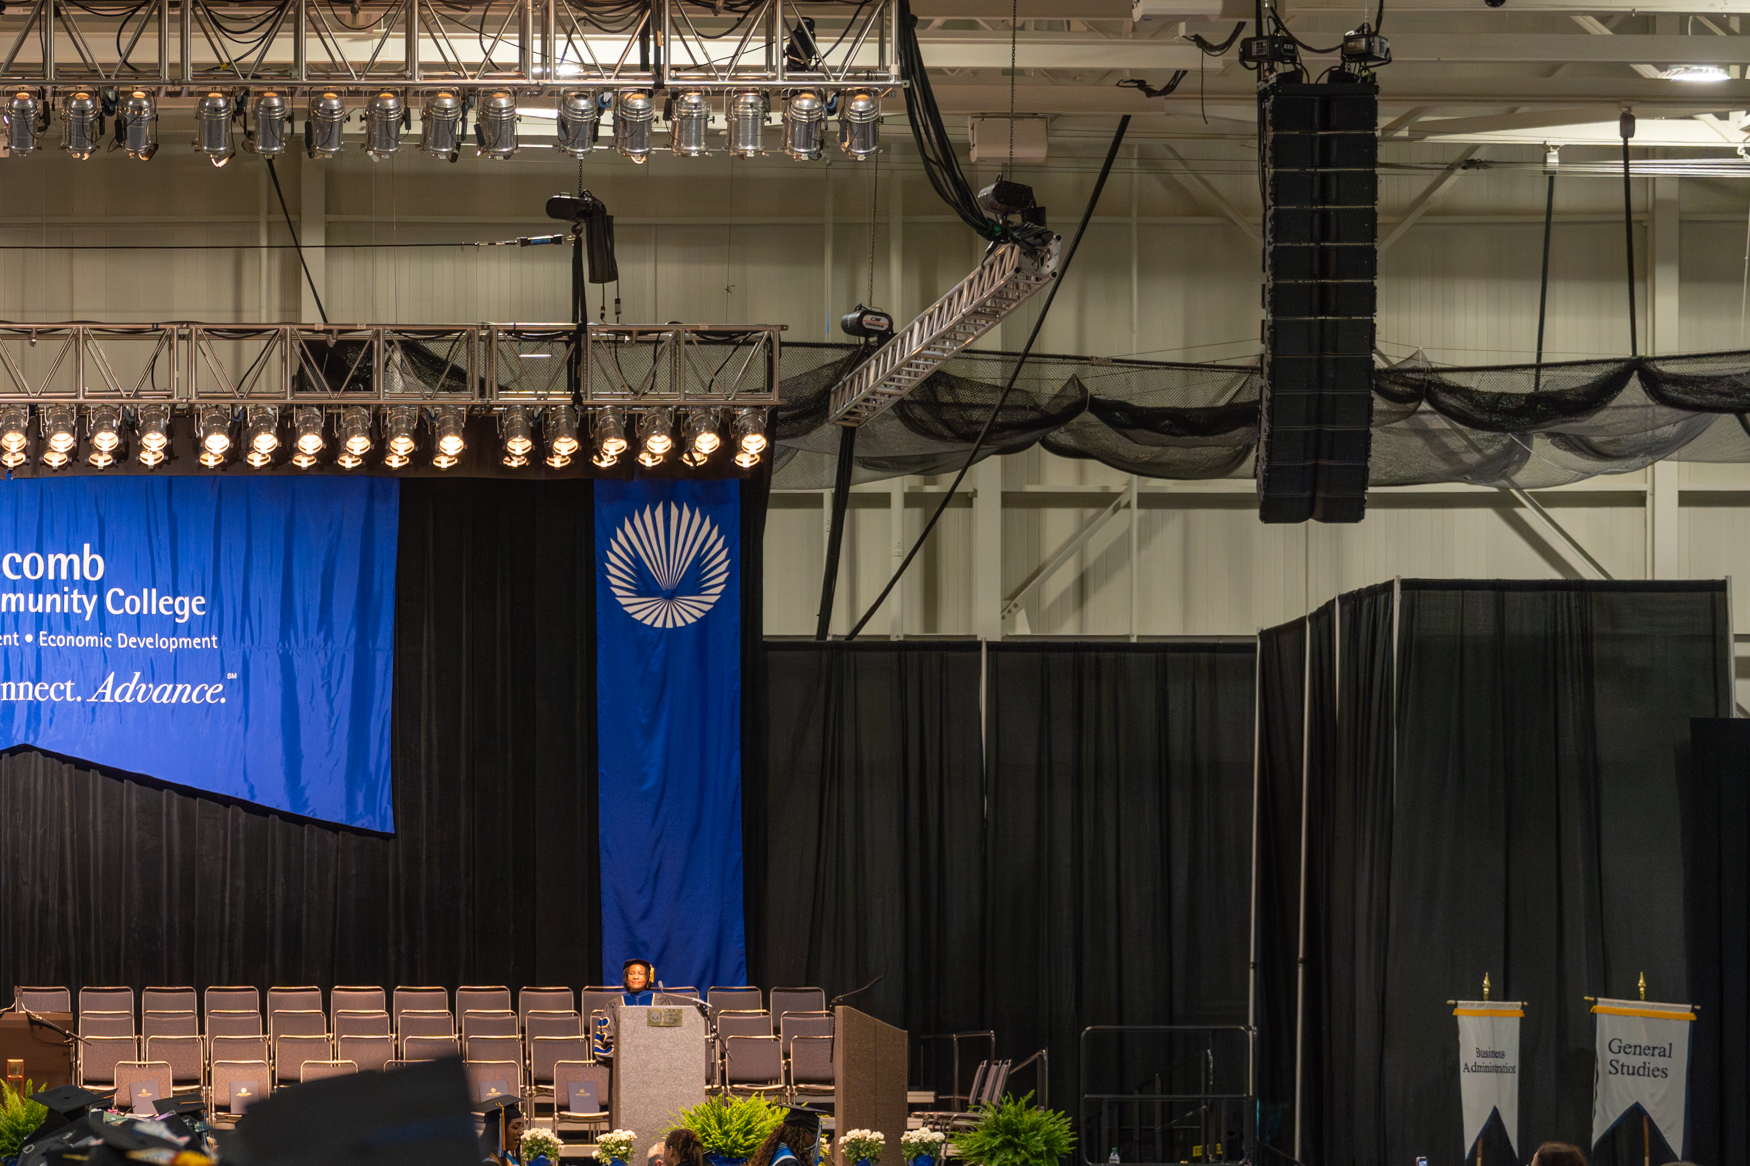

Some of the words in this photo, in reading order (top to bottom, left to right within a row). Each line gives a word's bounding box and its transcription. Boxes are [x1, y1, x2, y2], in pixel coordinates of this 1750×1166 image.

[105, 588, 206, 623] College
[39, 631, 113, 648] Economic
[117, 633, 218, 653] Development
[87, 672, 226, 704] Advance.
[1475, 1047, 1506, 1060] Business
[1607, 1037, 1673, 1059] General
[1608, 1059, 1669, 1080] Studies
